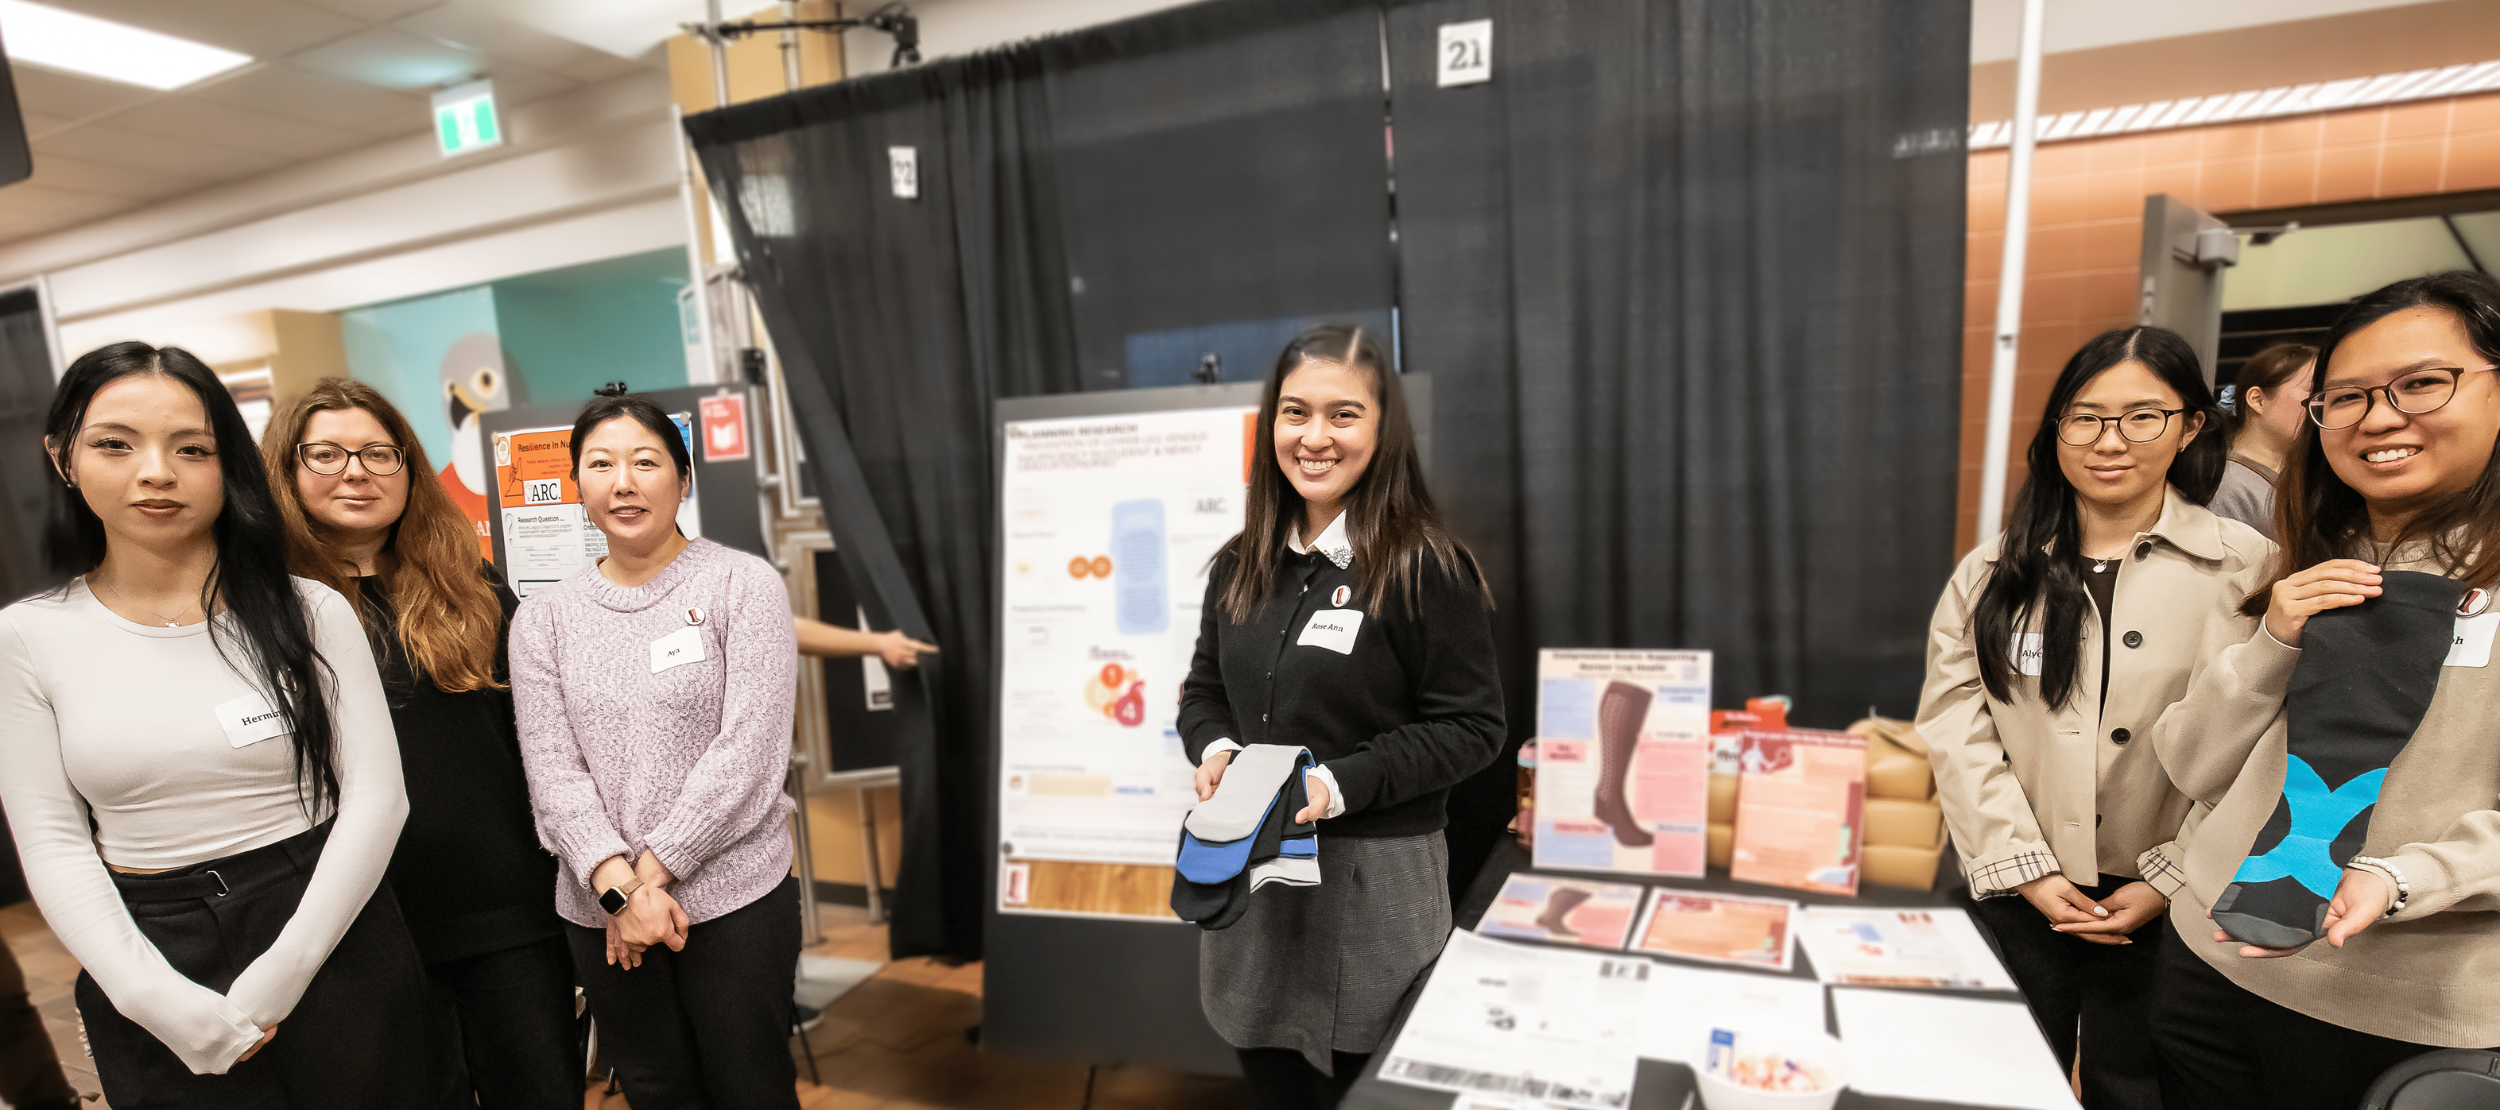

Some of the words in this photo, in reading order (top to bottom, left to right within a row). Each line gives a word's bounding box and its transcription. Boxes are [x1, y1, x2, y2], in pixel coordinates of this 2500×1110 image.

[1447, 39, 1484, 71] 21
[518, 442, 550, 453] Resilience
[532, 483, 561, 502] ARC.
[538, 515, 560, 524] Question
[1328, 624, 1344, 632] Ann
[667, 648, 681, 657] Aya
